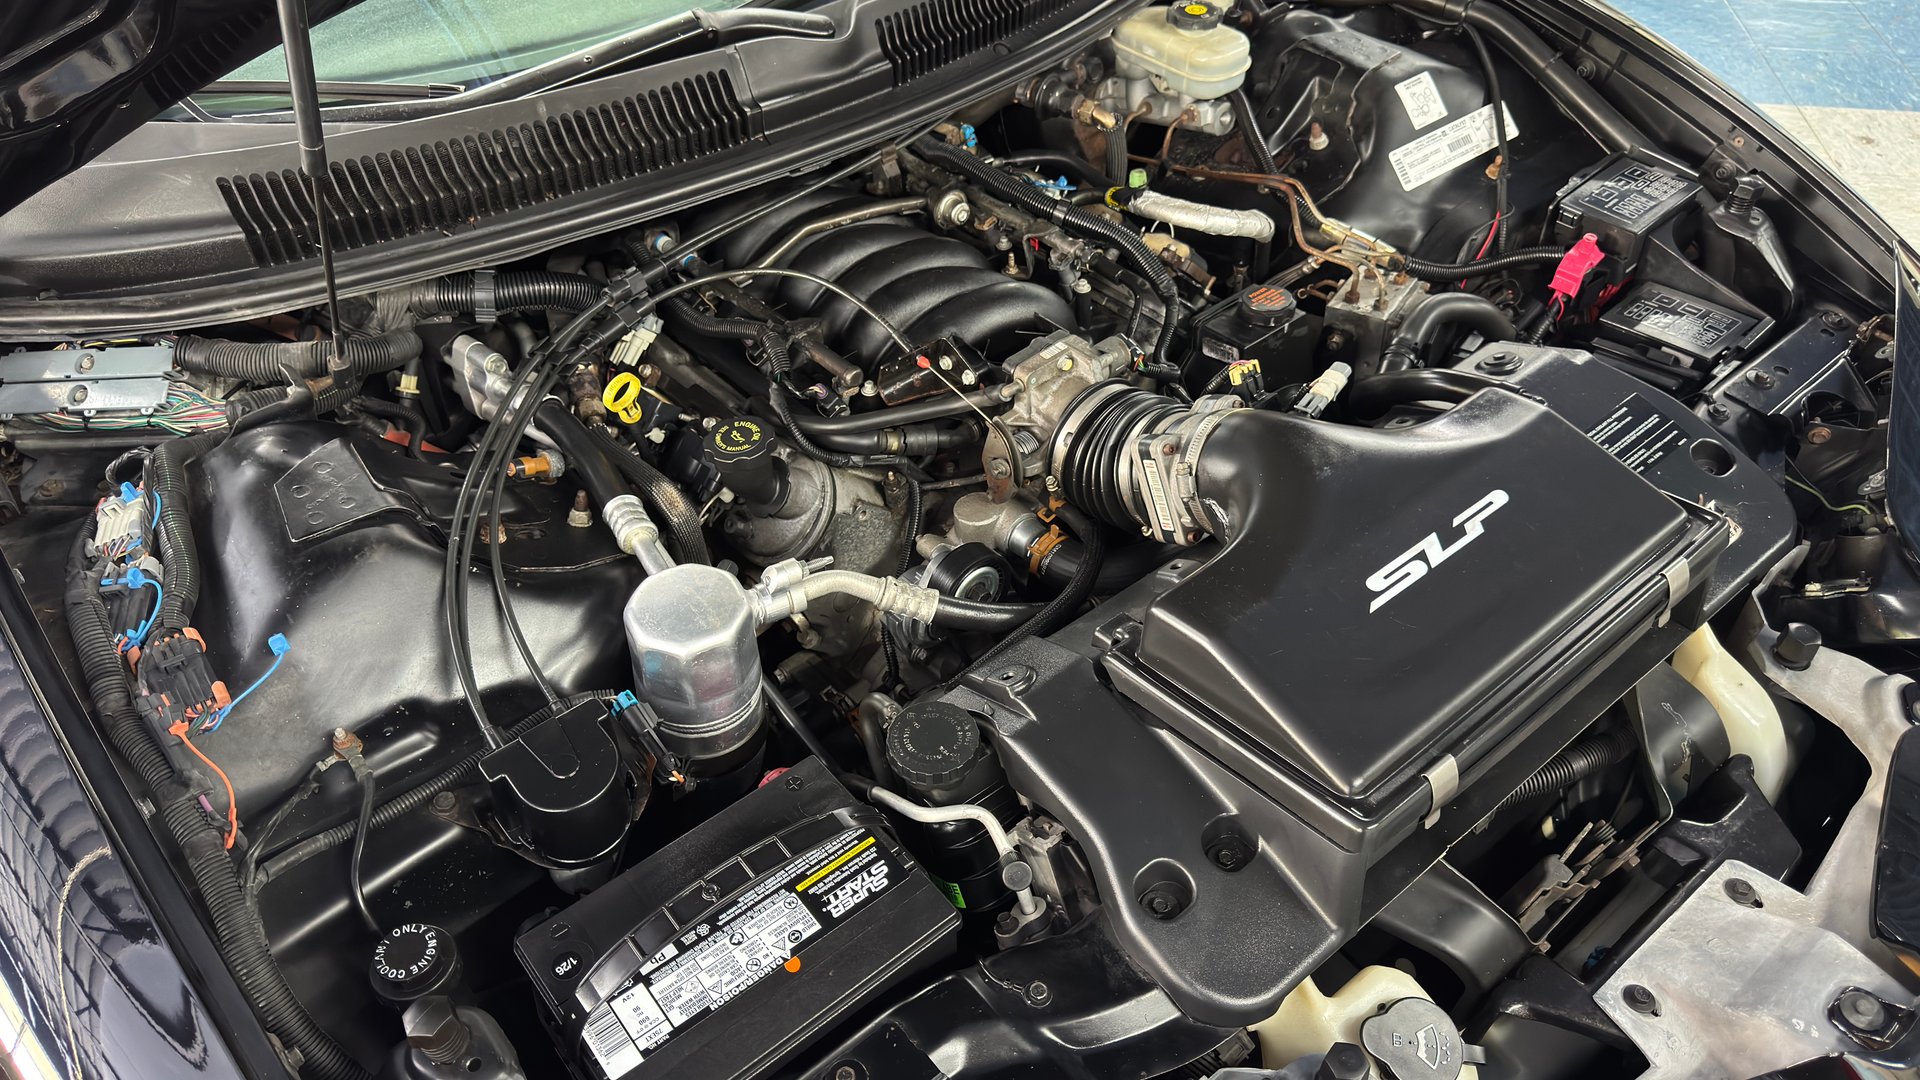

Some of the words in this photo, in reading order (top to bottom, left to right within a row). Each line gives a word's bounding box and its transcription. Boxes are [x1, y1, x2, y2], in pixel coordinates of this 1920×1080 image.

[734, 421, 760, 433] ENGINE
[751, 432, 761, 441] OIL
[1366, 489, 1509, 614] SLP
[827, 860, 888, 908] START
[831, 877, 888, 918] SUPER
[775, 908, 785, 917] KEEP
[787, 912, 809, 929] EXPLOSIVE
[801, 920, 816, 933] SHIELD
[393, 924, 428, 936] ONLY
[773, 926, 788, 938] GASES
[410, 932, 437, 974] ENGINE
[718, 945, 729, 954] READ
[649, 951, 666, 966] Pb
[555, 957, 578, 976] 1/26
[717, 967, 730, 977] CAUSE
[729, 966, 741, 976] ACID
[673, 974, 685, 984] OPEN
[708, 955, 784, 1011] DANGER/POISON
[722, 970, 745, 987] SULFURIC
[670, 985, 684, 996] HELP
[692, 989, 705, 999] WITH
[620, 992, 635, 1003] 12V
[658, 993, 672, 1004] FAST.
[661, 993, 682, 1008] MEDICAL
[664, 1004, 674, 1013] GET
[675, 997, 693, 1011] WATER.
[678, 993, 708, 1016] IMMEDIATELY
[696, 998, 711, 1010] FLUSH
[684, 1007, 697, 1017] EYES
[648, 1016, 660, 1026] CCA
[643, 1027, 663, 1043] 75EXT
[655, 1033, 669, 1044] PART
[646, 1041, 657, 1050] NO.
